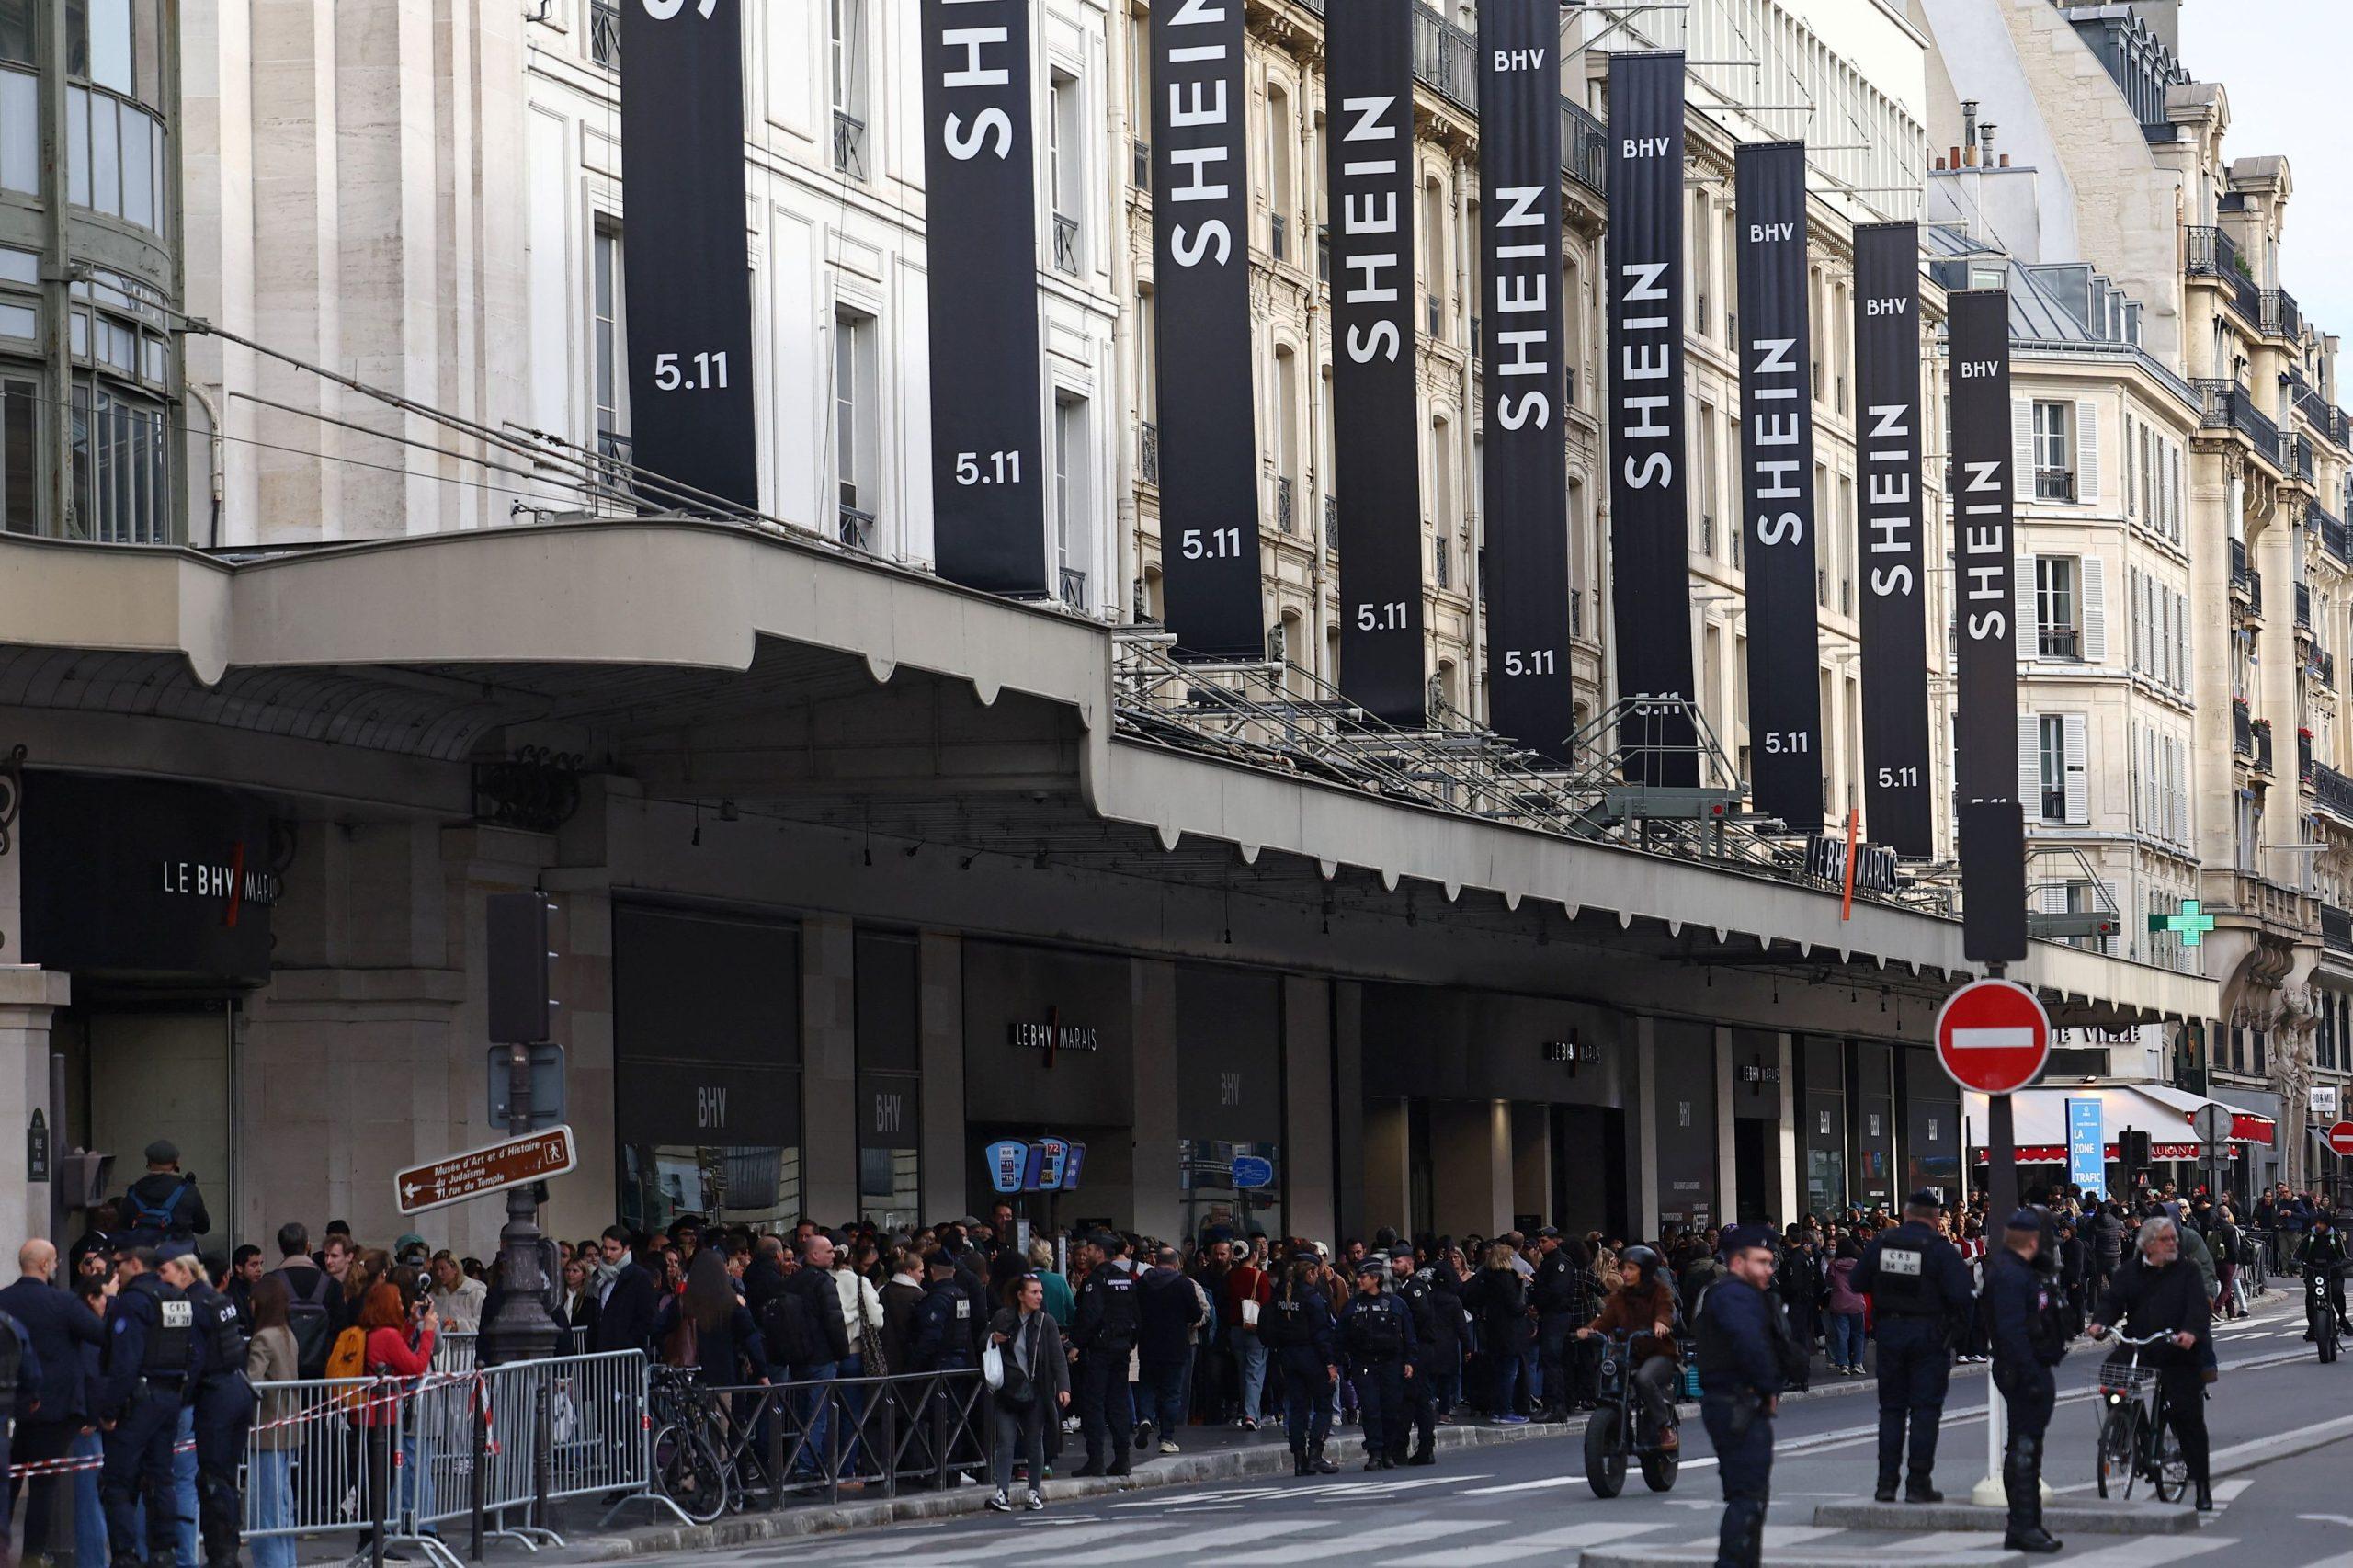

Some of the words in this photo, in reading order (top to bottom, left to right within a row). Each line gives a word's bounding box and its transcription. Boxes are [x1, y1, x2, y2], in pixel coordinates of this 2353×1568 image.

[1494, 49, 1545, 72] BHV
[942, 0, 1013, 161] SH
[1623, 137, 1670, 159] BHV
[1342, 96, 1400, 364] SHEIN
[1750, 222, 1794, 243] BHV
[1495, 186, 1550, 431] SHEIN
[1867, 297, 1907, 316] BHV
[655, 352, 728, 391] 5.11
[1622, 262, 1672, 489] SHEIN
[1961, 360, 1999, 378] BHV
[1752, 338, 1803, 546] SHEIN
[956, 450, 1020, 485] 5.11
[1868, 404, 1913, 597] SHEIN
[1182, 528, 1240, 560] 5.11
[1964, 461, 2006, 640] SHEIN
[1358, 602, 1407, 631] 5.11
[1505, 649, 1554, 676] 5.11
[1634, 691, 1680, 716] 5.11
[1765, 731, 1808, 754] 5.11
[1879, 767, 1917, 788] 5.11
[1811, 835, 1825, 877] LE
[1856, 846, 1898, 894] MARAIS
[165, 860, 188, 893] LE
[197, 864, 234, 899] BHV
[1017, 1023, 1029, 1046] LE
[1030, 1024, 1052, 1048] BHV
[1060, 1027, 1097, 1051] MARAIS
[2084, 1025, 2140, 1043] VILLE
[1221, 1073, 1240, 1106] BHV
[698, 1086, 726, 1128] BHV
[876, 1094, 901, 1132] BHV
[2074, 1129, 2084, 1140] LA
[434, 1163, 460, 1177] Musée
[462, 1154, 485, 1170] d'Art
[487, 1153, 496, 1163] et
[499, 1141, 540, 1158] d'Histoire
[1049, 1144, 1059, 1153] 72
[2074, 1143, 2095, 1154] ZONE
[2075, 1155, 2081, 1168] À
[2151, 1145, 2194, 1155] AURANT
[436, 1176, 446, 1187] du
[449, 1167, 486, 1185] Judaïsme
[449, 1186, 462, 1197] rue
[464, 1181, 475, 1192] du
[477, 1172, 505, 1188] Temple
[2075, 1172, 2102, 1183] TRAFIC
[1890, 1252, 1911, 1261] CRS
[1278, 1301, 1300, 1312] POLCE
